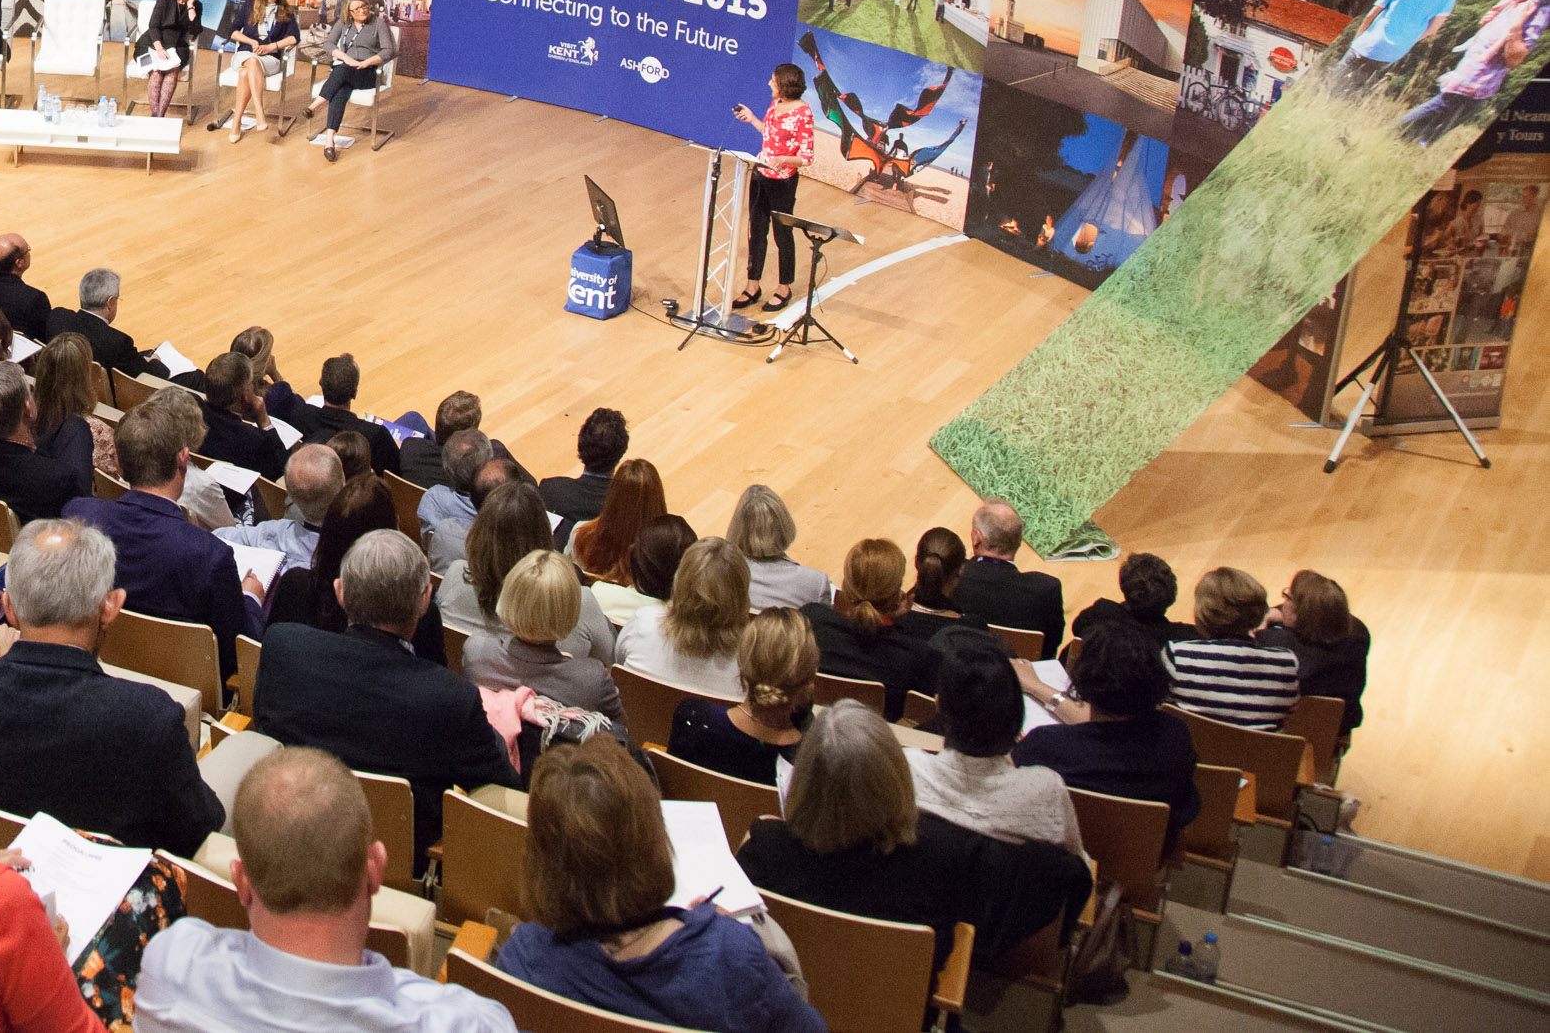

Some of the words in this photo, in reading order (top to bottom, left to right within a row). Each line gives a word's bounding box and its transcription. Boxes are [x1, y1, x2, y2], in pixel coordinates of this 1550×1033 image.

[610, 6, 630, 28] to
[636, 12, 669, 38] the
[675, 19, 739, 55] Future
[548, 45, 580, 59] KENT
[560, 41, 577, 50] VISIT
[619, 56, 670, 79] ASHFORD
[1510, 129, 1544, 140] Tours
[608, 274, 618, 286] of
